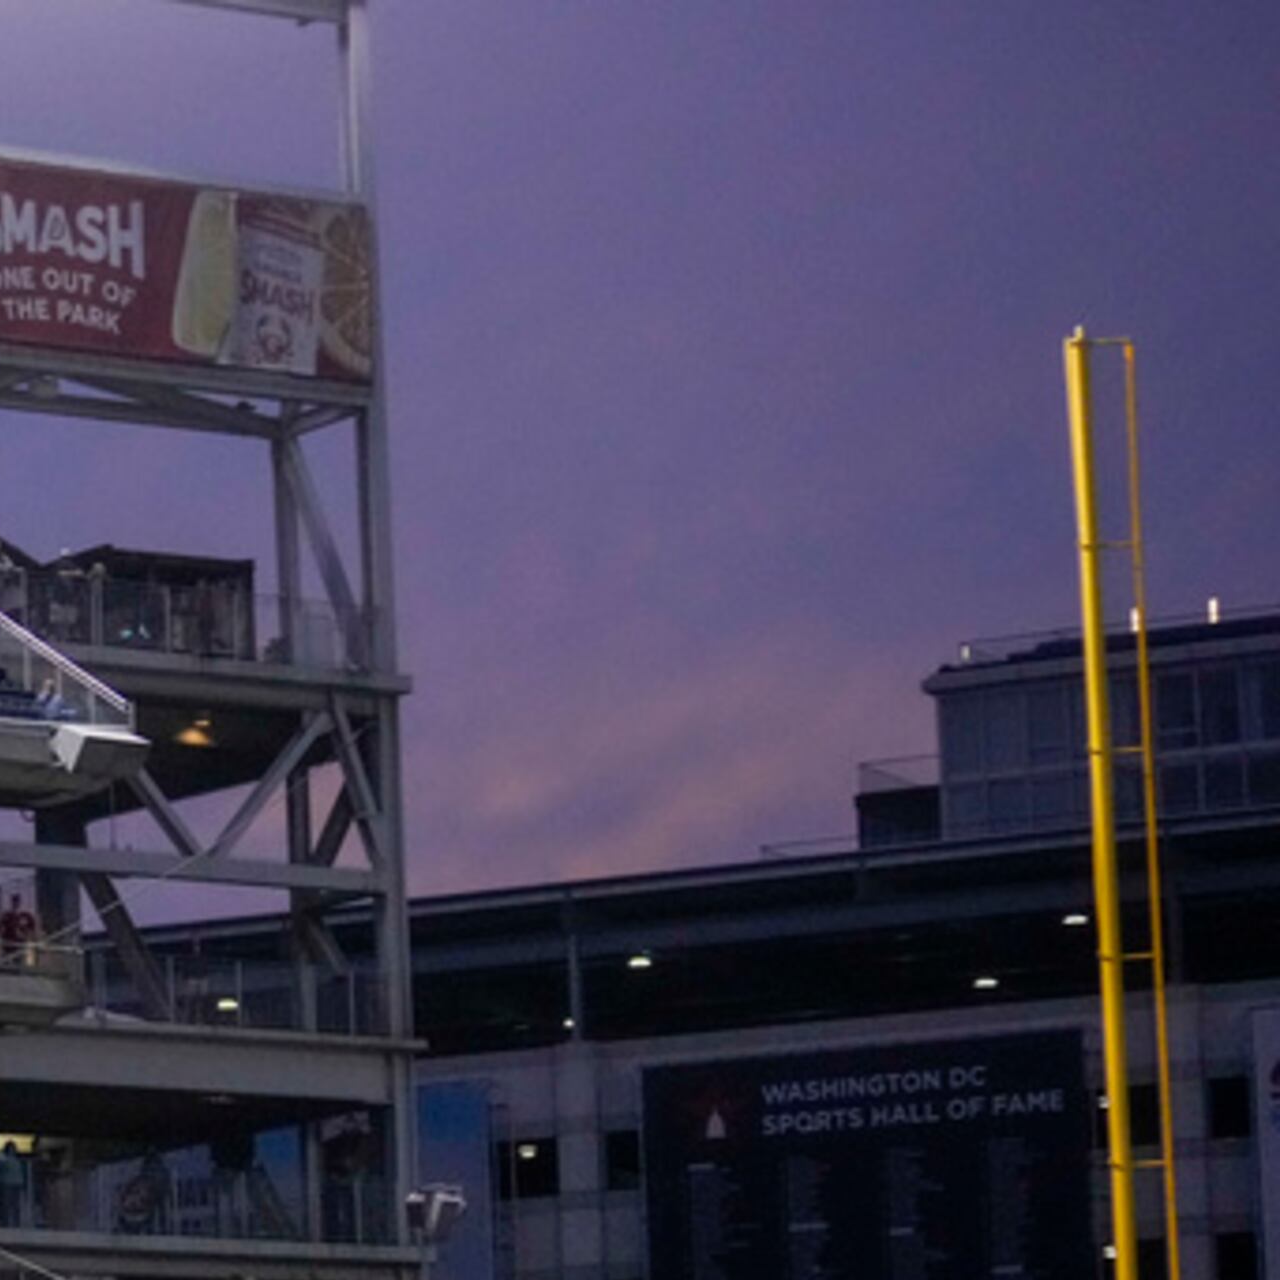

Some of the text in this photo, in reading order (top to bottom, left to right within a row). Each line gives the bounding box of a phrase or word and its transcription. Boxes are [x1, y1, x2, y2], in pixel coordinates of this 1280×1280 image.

[41, 268, 95, 295] OUT
[101, 281, 137, 307] OF
[1, 299, 122, 335] THE PARK
[761, 1065, 987, 1105] WASHINGTON DC
[762, 1088, 1065, 1136] SPORTS HALL OF FAME
